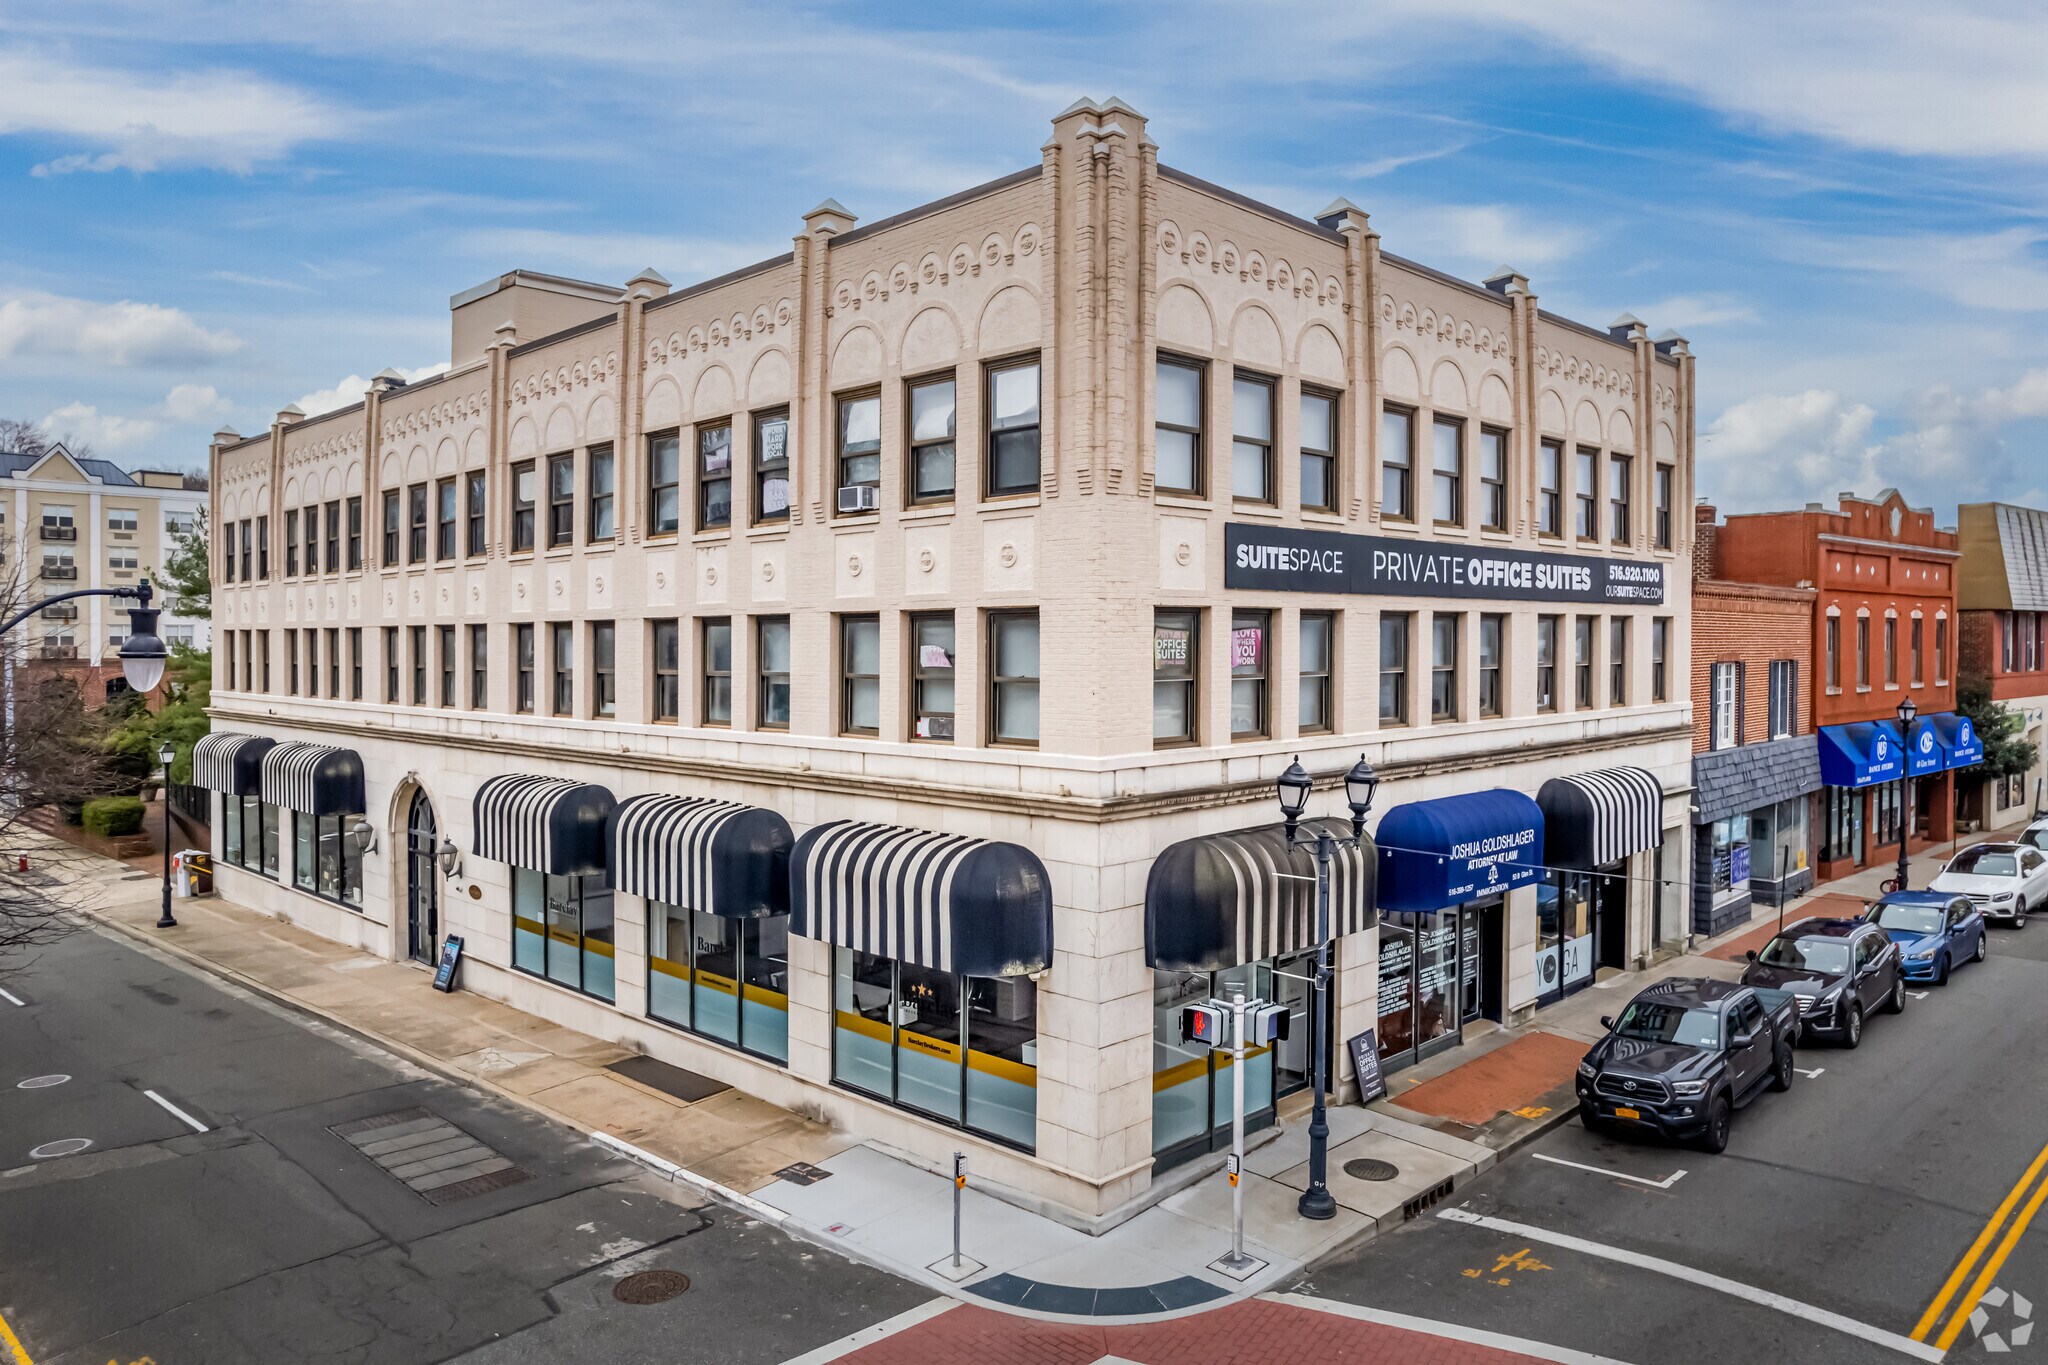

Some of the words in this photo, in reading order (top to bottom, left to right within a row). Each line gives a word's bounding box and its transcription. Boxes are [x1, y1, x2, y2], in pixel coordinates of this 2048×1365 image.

[1236, 543, 1344, 574] SUITESPACE
[1373, 550, 1465, 586] PRIVATE
[1467, 558, 1532, 588] OFFICE
[1535, 564, 1592, 591] SUITES
[1608, 565, 1660, 583] 516.920.1100
[1605, 584, 1663, 600] OURSUITESPACE.COM
[1236, 628, 1256, 638] LOVE
[1156, 639, 1187, 650] OFFICE
[1238, 646, 1256, 657] YOU
[1157, 649, 1186, 660] SUITES
[1450, 840, 1481, 860] JOSHUA
[1481, 829, 1535, 853] GOLDSHLAGER
[1467, 854, 1497, 871] ATTORNEY
[1497, 852, 1505, 863] AT
[1505, 850, 1518, 862] LAW
[1476, 882, 1509, 897] IMMIGRATION
[1379, 945, 1412, 961] OLDSHLAGER
[1359, 1054, 1376, 1067] OFFICE
[1360, 1061, 1378, 1074] SUITES
